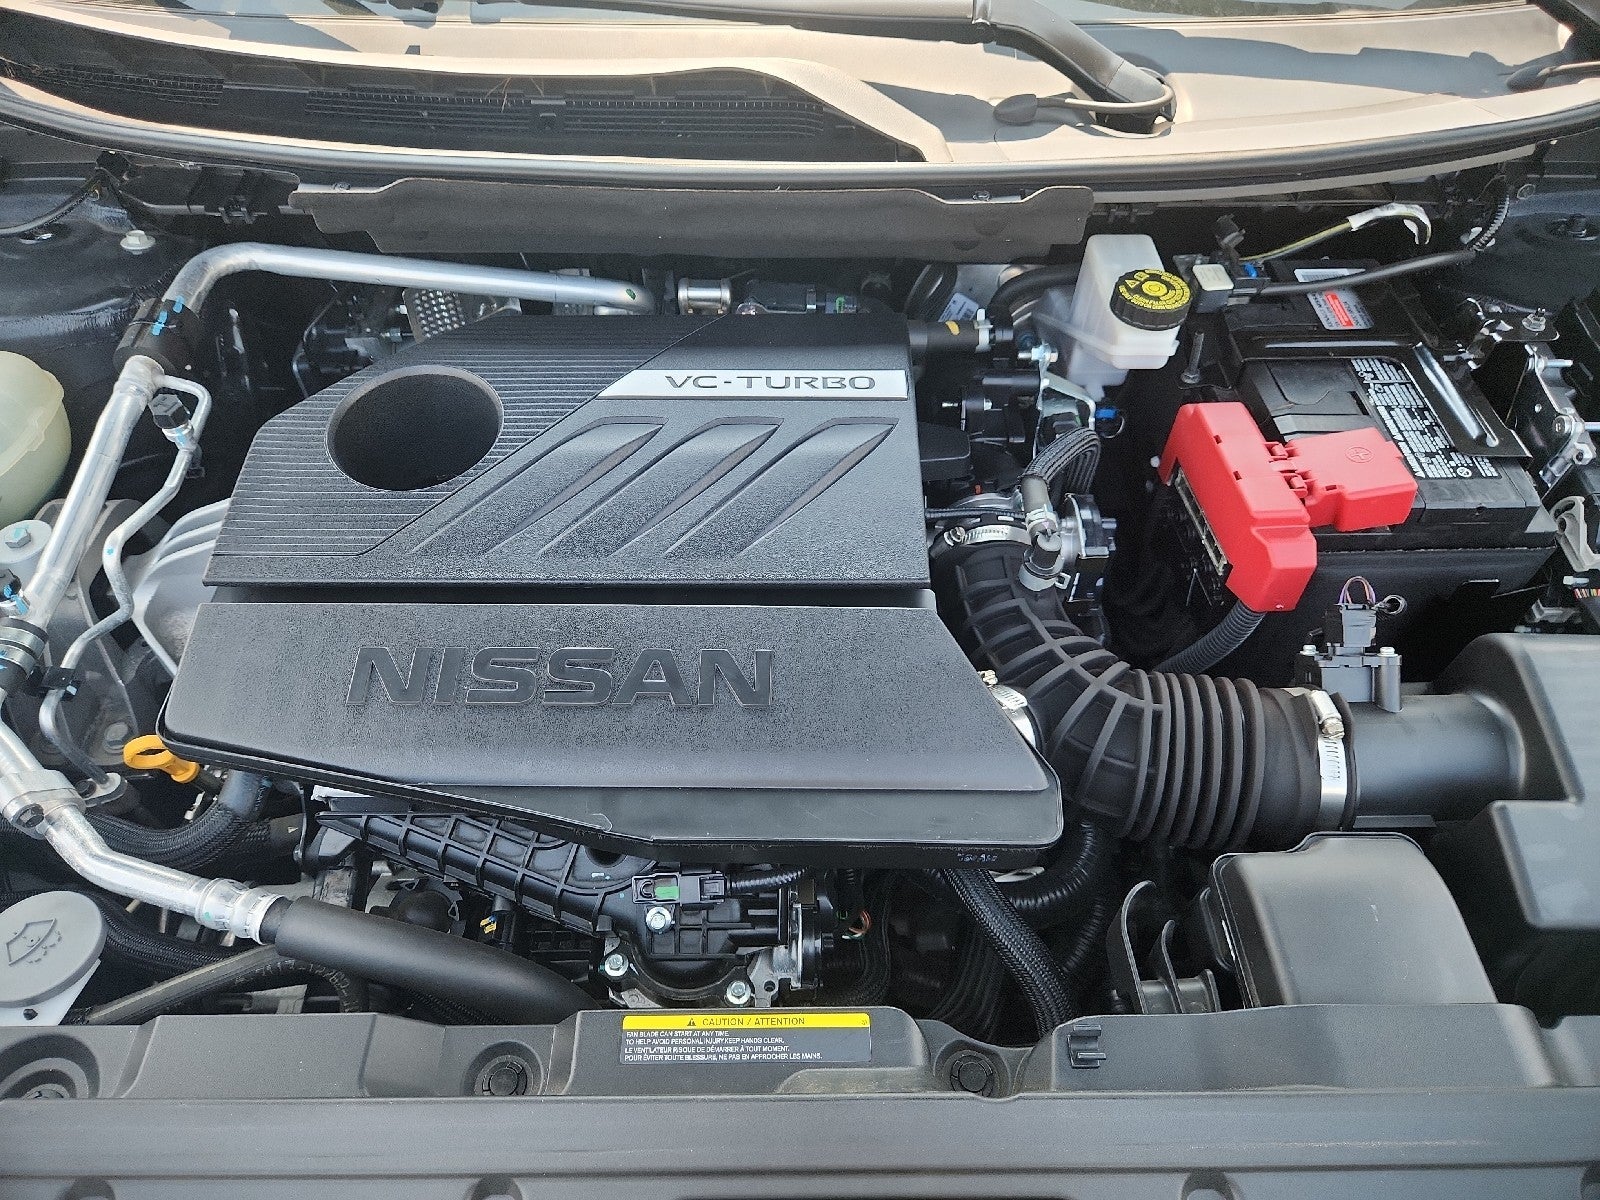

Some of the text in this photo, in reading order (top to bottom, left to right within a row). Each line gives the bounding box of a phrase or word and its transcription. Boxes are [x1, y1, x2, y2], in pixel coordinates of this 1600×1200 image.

[345, 646, 774, 707] NISSAN
[702, 1018, 744, 1026] CAUTION
[754, 1017, 805, 1025] ATTENTION
[706, 1045, 739, 1053] DÉMARRER
[643, 1053, 664, 1061] ÉVITER
